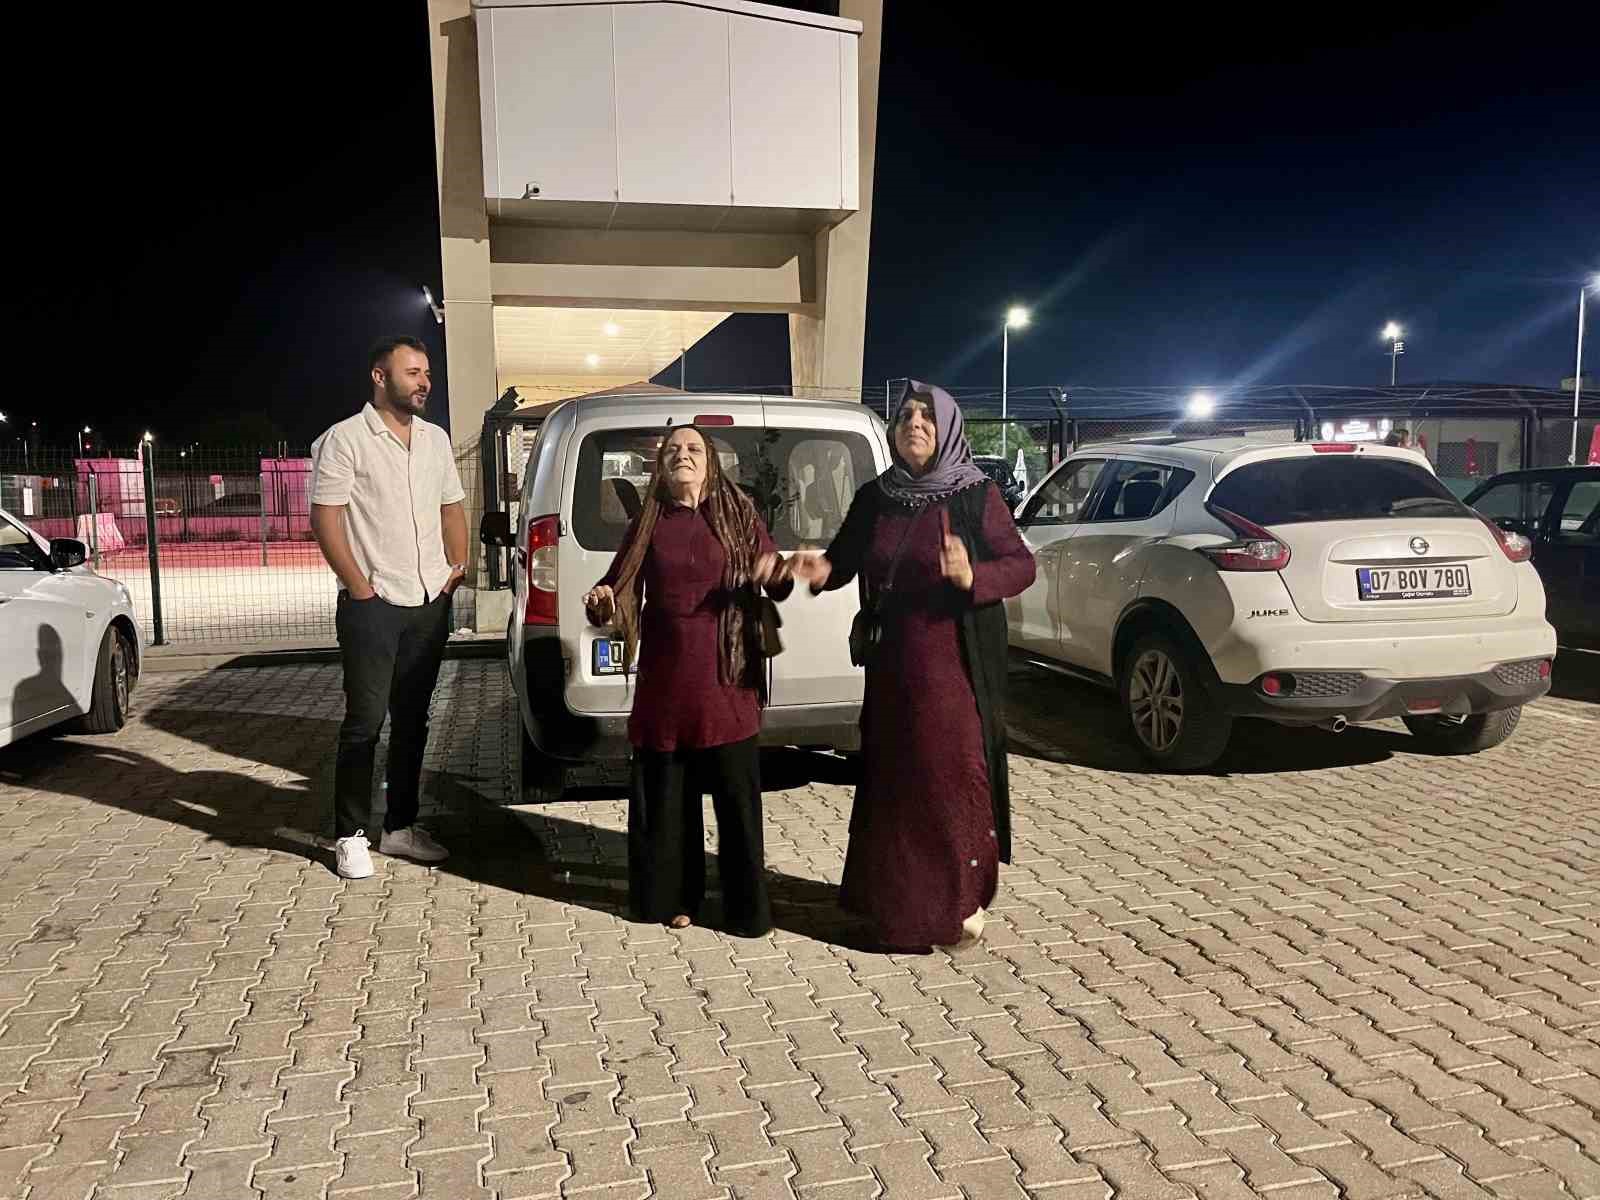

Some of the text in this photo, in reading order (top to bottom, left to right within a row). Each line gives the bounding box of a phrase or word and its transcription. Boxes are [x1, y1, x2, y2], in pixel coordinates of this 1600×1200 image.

[1371, 569, 1465, 591] 07 BOV 780
[1246, 609, 1289, 620] JUKE
